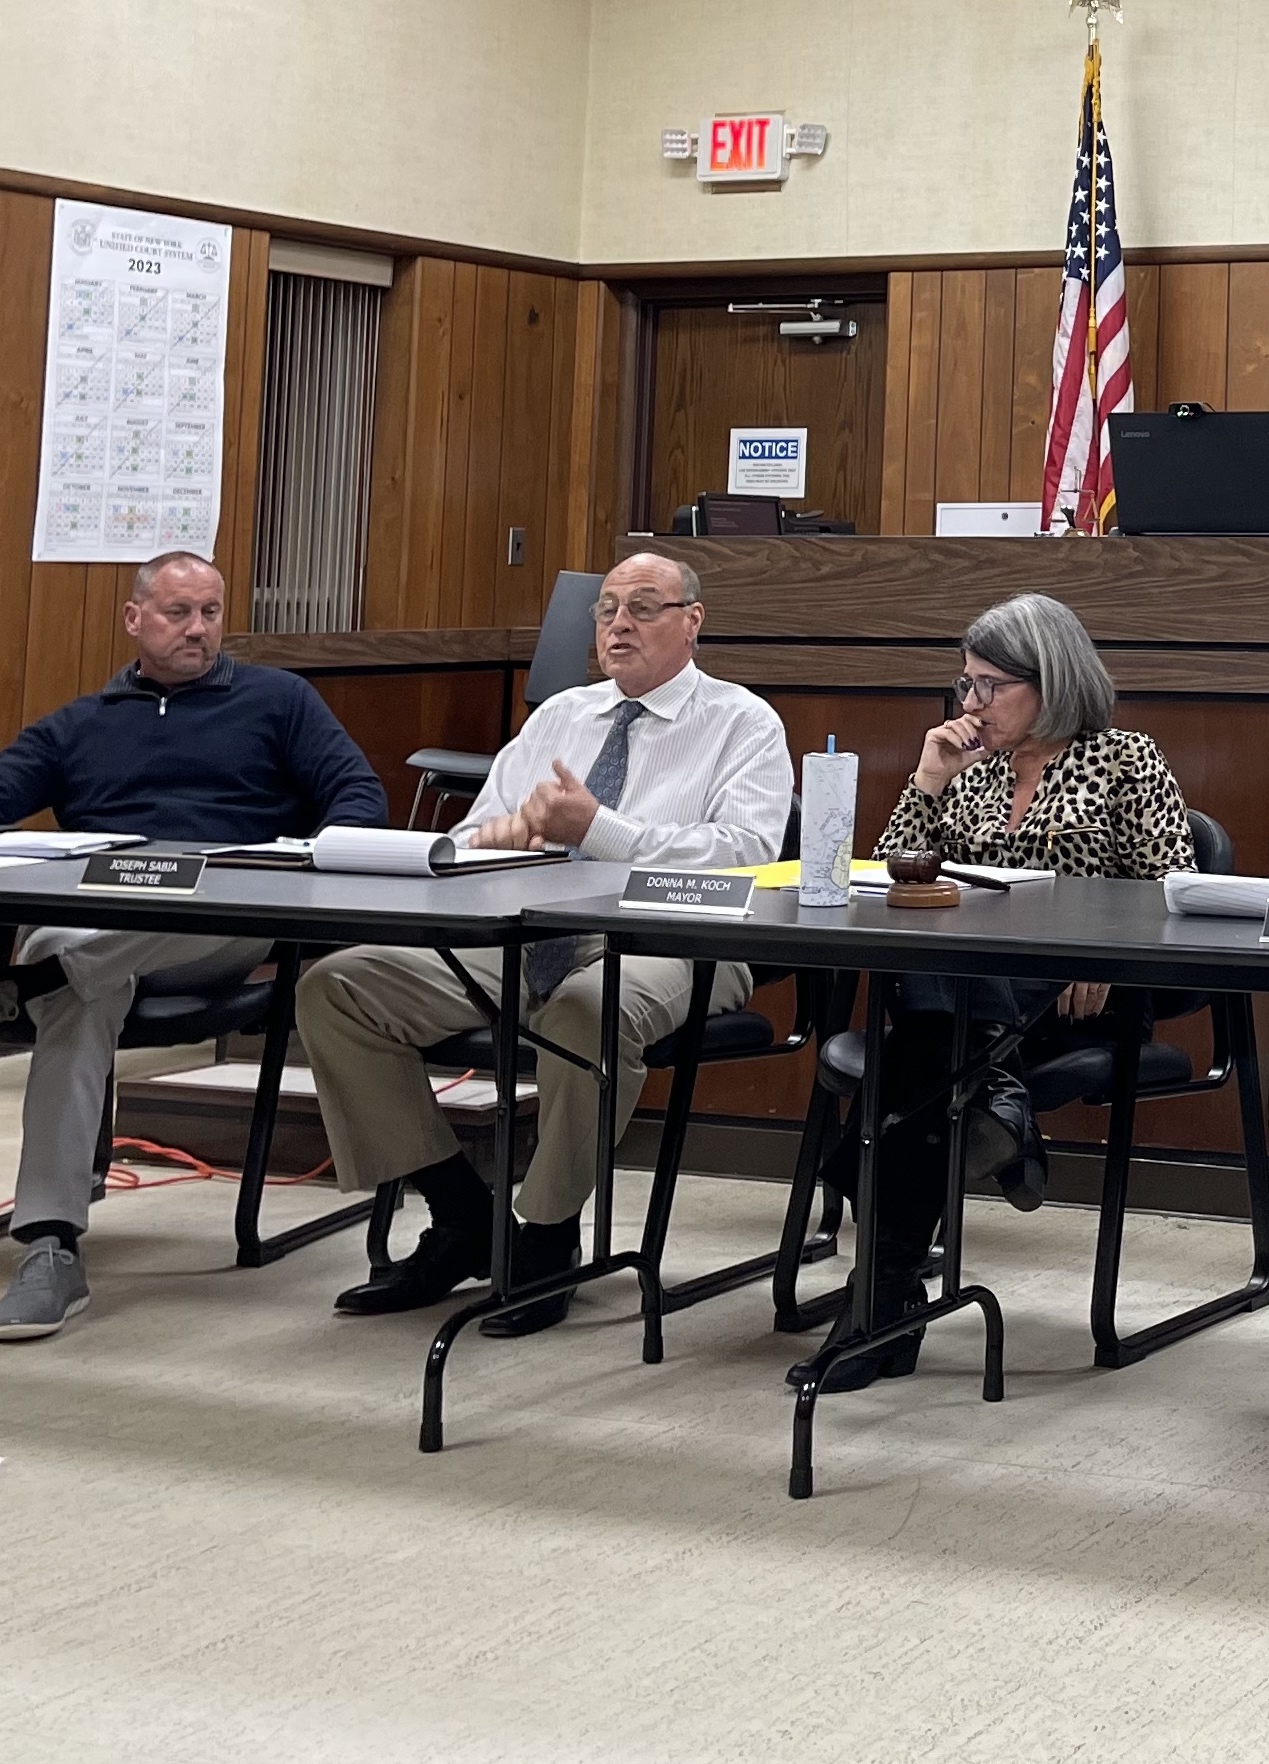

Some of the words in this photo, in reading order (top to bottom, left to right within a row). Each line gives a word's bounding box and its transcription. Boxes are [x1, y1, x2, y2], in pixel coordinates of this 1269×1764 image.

[710, 118, 771, 171] EXIT
[145, 236, 163, 246] NEW
[134, 243, 162, 257] COURT
[163, 247, 194, 261] SYSTEM
[128, 258, 162, 275] 2023
[1120, 430, 1151, 438] Lenovo
[739, 441, 798, 458] NOTICE
[109, 859, 148, 871] JOSEPH
[148, 861, 178, 873] SABIA
[119, 872, 162, 885] TRUSTEE
[646, 876, 683, 889] DONNA
[686, 879, 697, 890] M.
[701, 880, 731, 891] KOCH
[666, 891, 703, 903] MAYOR
